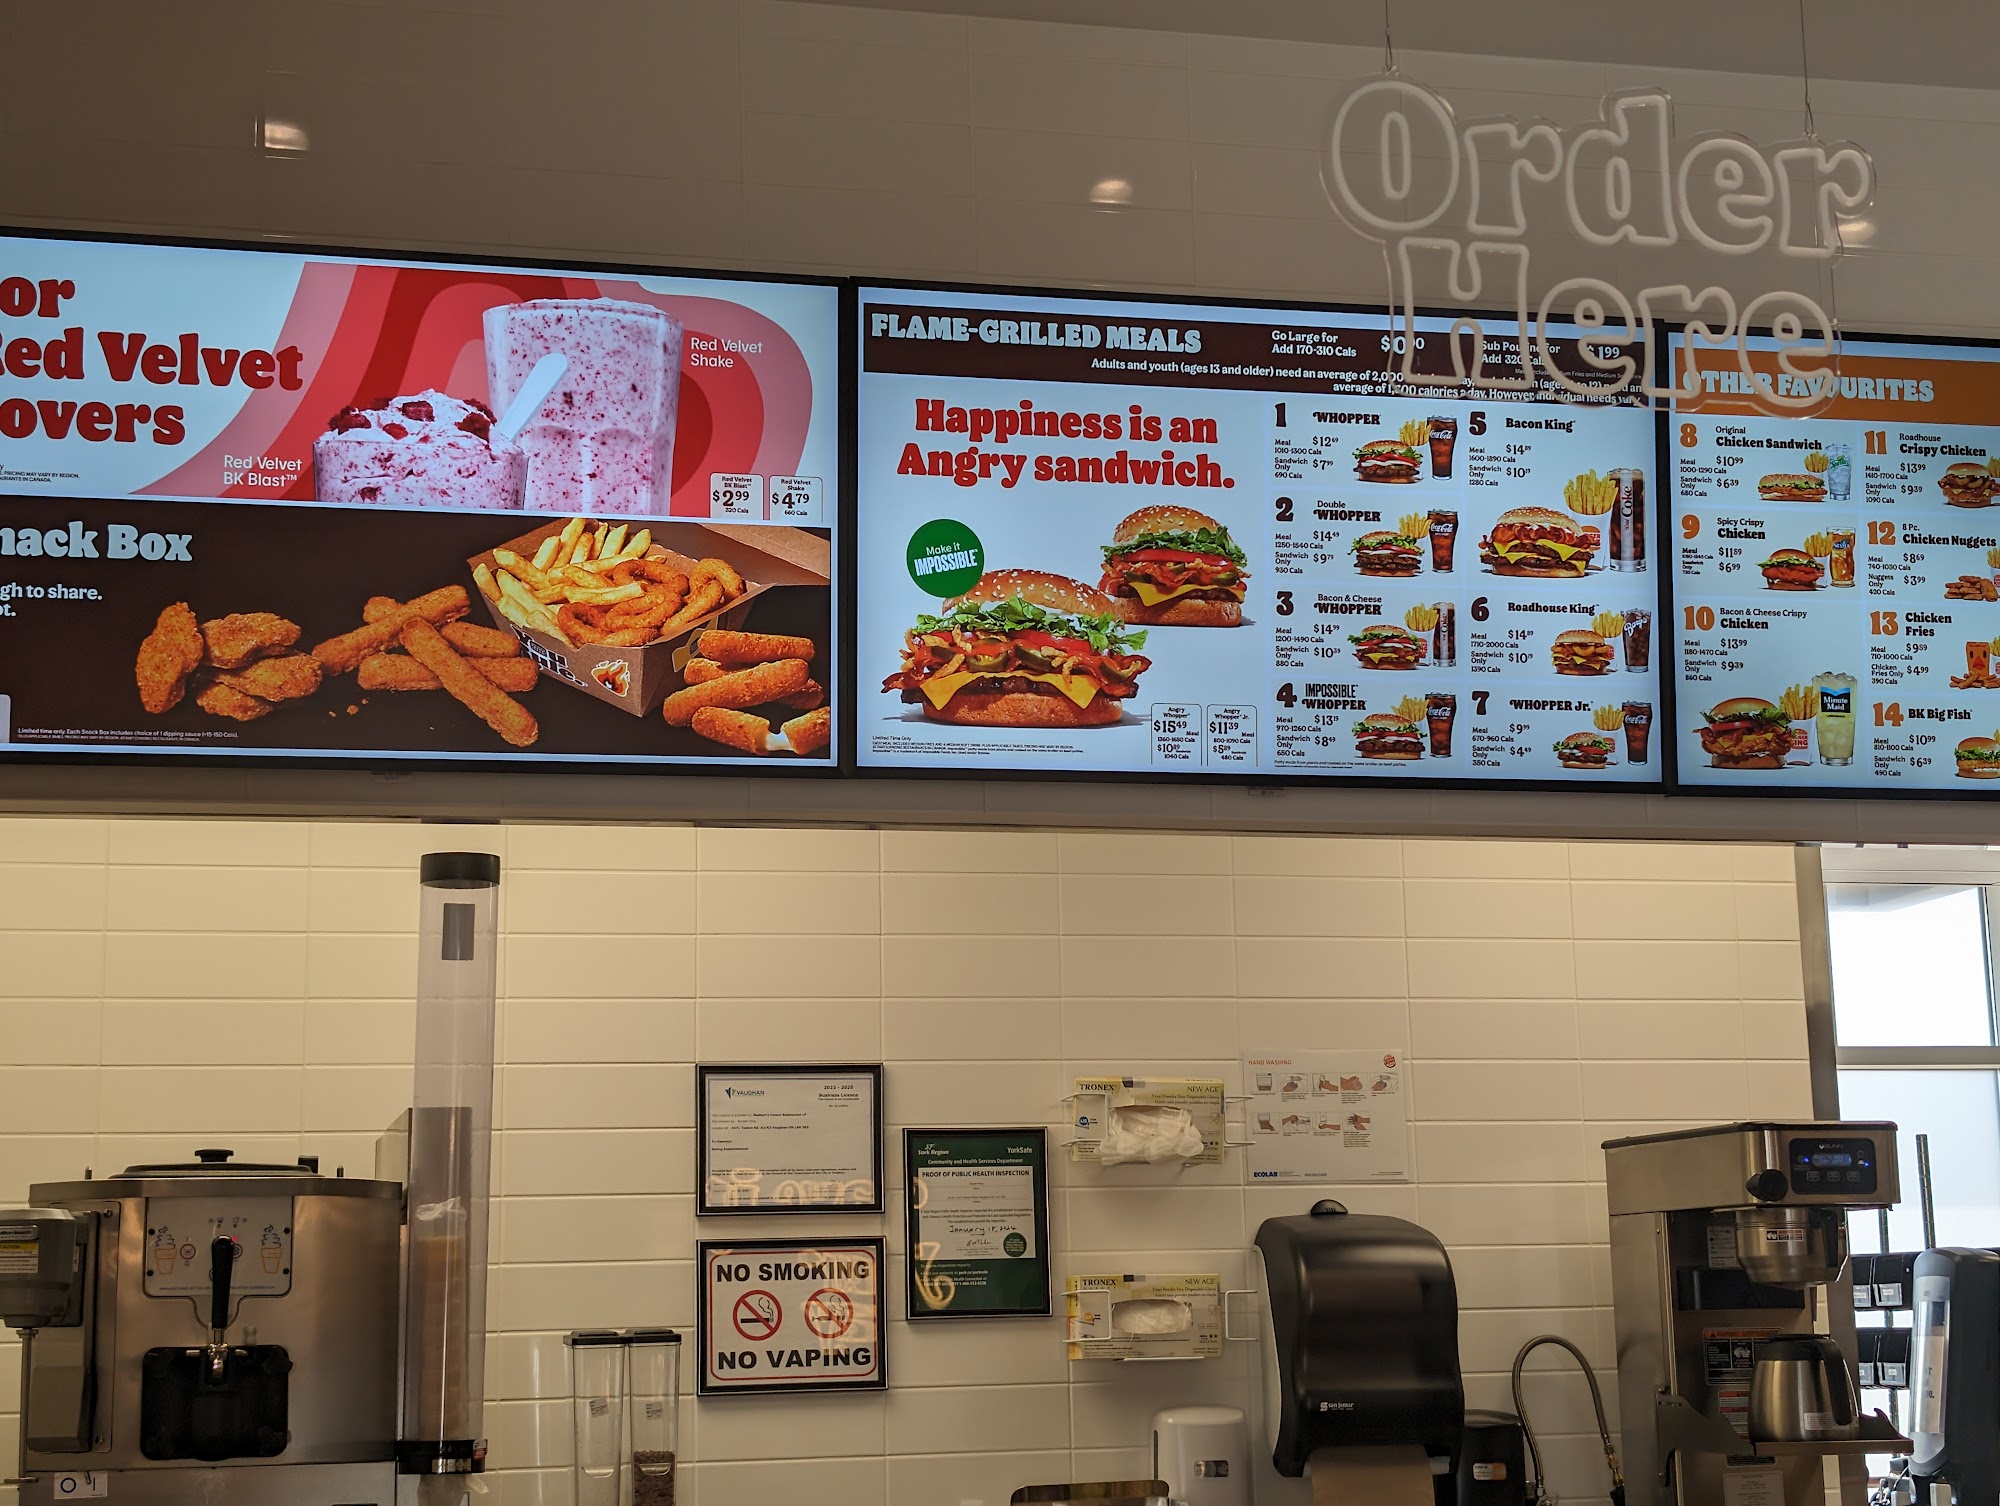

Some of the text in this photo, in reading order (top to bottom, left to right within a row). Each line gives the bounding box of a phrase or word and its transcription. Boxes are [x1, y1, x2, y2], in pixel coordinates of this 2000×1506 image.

[1333, 80, 1872, 257] Order
[1400, 238, 1835, 407] Here
[871, 313, 1202, 354] FLAME-GRILLED MEALS
[1271, 330, 1339, 344] Go Large for
[690, 337, 763, 354] Red Velvet
[1271, 343, 1357, 358] Add 170-310 Cals
[0, 327, 304, 391] ed Velvet
[690, 353, 734, 368] Shake
[1091, 357, 1125, 371] Adults
[1127, 360, 1147, 372] and
[1148, 360, 1179, 374] youth
[1180, 361, 1208, 376] (ages
[1209, 362, 1221, 374] 13
[1222, 363, 1242, 375] and
[1243, 363, 1274, 378] older)
[1276, 366, 1301, 378] need
[1302, 369, 1316, 379] an
[1317, 370, 1358, 382] average
[1359, 370, 1371, 381] of
[915, 398, 1218, 444] Happiness is an
[1274, 402, 1287, 428] 1
[1312, 411, 1381, 425] WHOPPER
[1469, 411, 1487, 436] 5
[1505, 417, 1574, 433] Bacon King
[1715, 425, 1746, 435] Original
[1679, 422, 1698, 448] 8
[1864, 430, 1887, 455] 11
[1899, 433, 1942, 442] Roadhouse
[1715, 436, 1823, 450] Chicken Sandwich
[1899, 443, 1987, 457] Crispy Chicken
[223, 454, 303, 471] Red Velvet
[896, 442, 1235, 489] Angry sandwich.
[223, 472, 244, 486] BK
[1275, 496, 1294, 522] 2
[1317, 500, 1346, 509] Double
[1312, 509, 1382, 522] WHOPPER
[1717, 517, 1765, 528] Spicy Crispy
[1681, 514, 1700, 540] 9
[1717, 527, 1766, 540] Chicken
[1867, 520, 1896, 546] 12
[1902, 523, 1920, 531] 8 Pc.
[107, 524, 193, 562] Box
[926, 541, 961, 556] Make it
[1902, 533, 1997, 549] Chicken Nuggets
[26, 583, 45, 598] to
[47, 583, 103, 601] share.
[1317, 593, 1343, 602] Bacon
[1352, 594, 1382, 603] Cheese
[1276, 590, 1295, 616] 3
[1313, 602, 1382, 616] WHOPPER
[1471, 596, 1490, 622] 6
[1507, 601, 1595, 617] Roadhouse King
[1683, 605, 1715, 631] 10
[1719, 607, 1808, 619] Bacon & Cheese Crispy
[1905, 612, 1952, 624] Chicken
[1719, 617, 1769, 630] Chicken
[1869, 610, 1899, 636] 13
[1905, 625, 1935, 637] Fries
[1276, 682, 1298, 708] 4
[1823, 696, 1849, 704] Minute
[1301, 698, 1367, 711] WHOPPER
[1472, 690, 1490, 716] 7
[1509, 699, 1592, 712] WHOPPER Jr.
[1826, 703, 1845, 711] Maid
[1872, 702, 1905, 727] 14
[1908, 708, 1972, 722] BK Big Fish
[1079, 1083, 1115, 1091] TRONEX
[930, 1149, 950, 1157] Region
[1006, 1146, 1033, 1154] YorkSafe
[996, 1157, 1024, 1165] Department
[716, 1261, 870, 1282] NO SMOKING
[1082, 1278, 1117, 1286] TRONEX
[718, 1347, 871, 1370] NO VAPING
